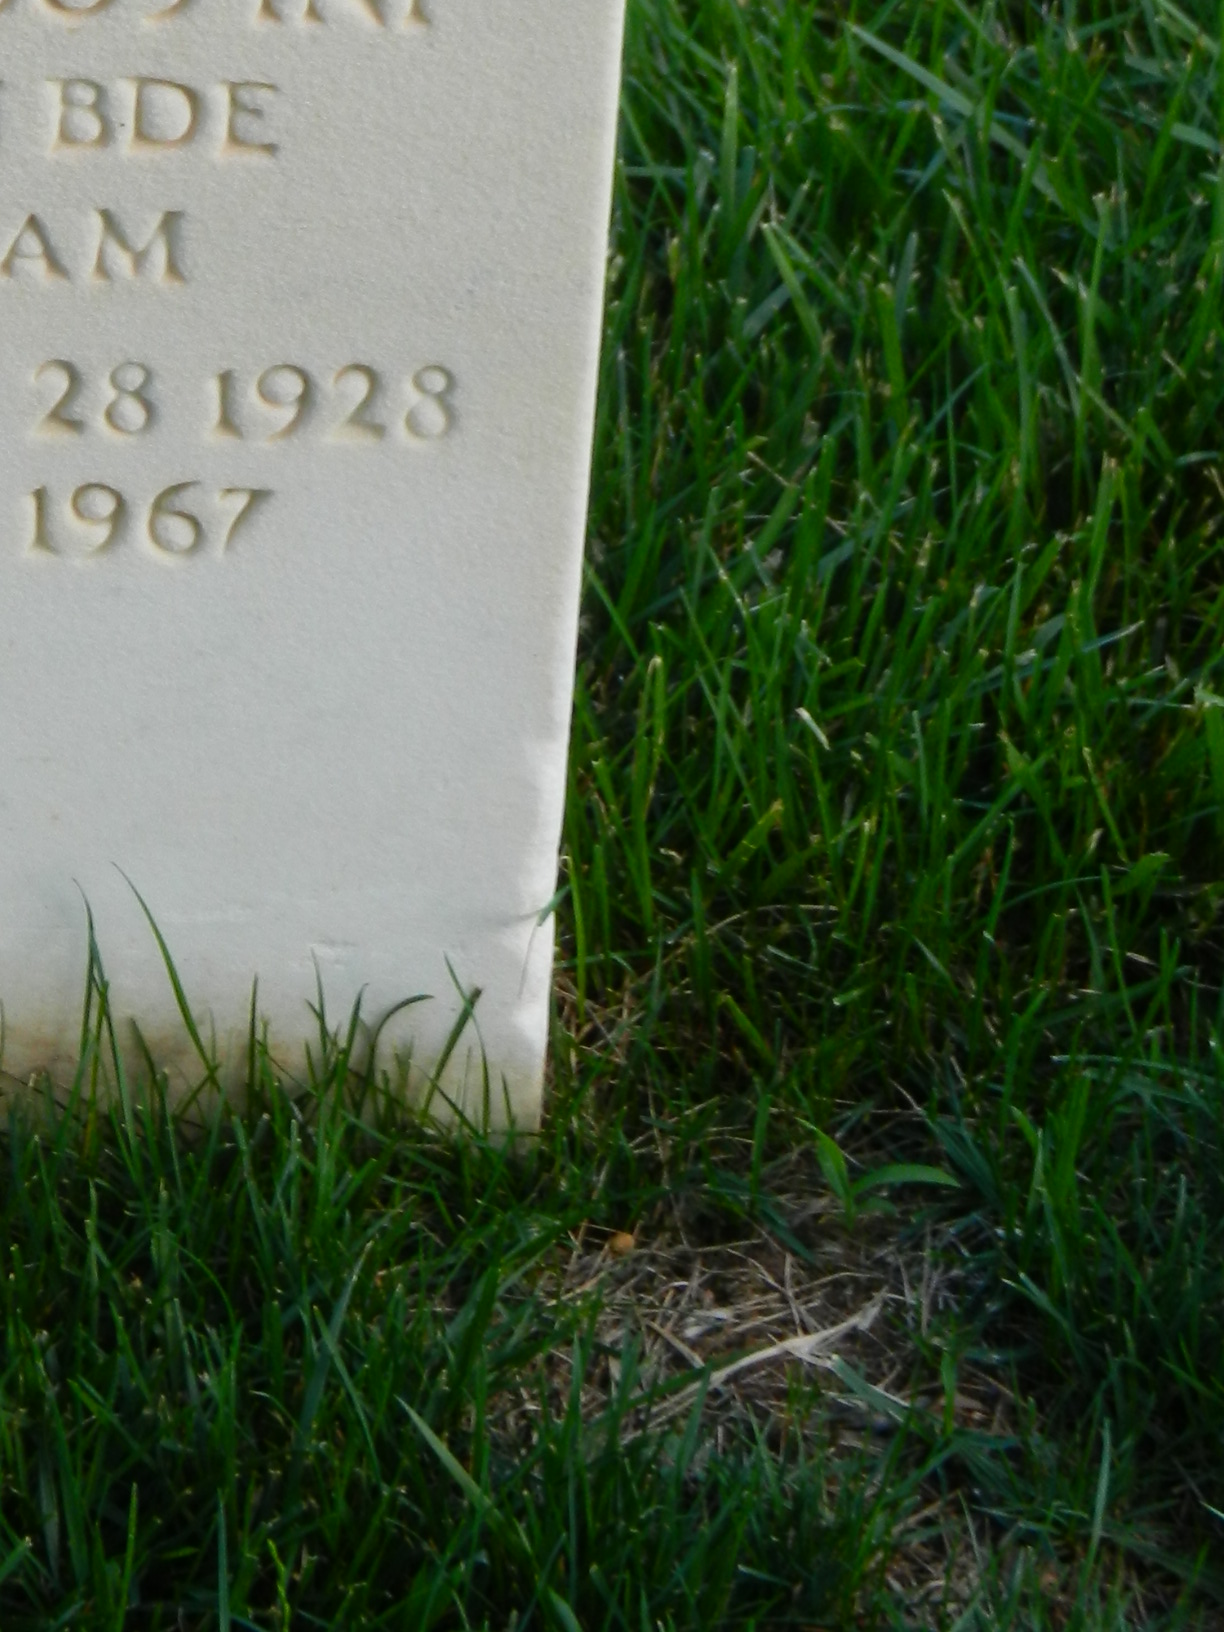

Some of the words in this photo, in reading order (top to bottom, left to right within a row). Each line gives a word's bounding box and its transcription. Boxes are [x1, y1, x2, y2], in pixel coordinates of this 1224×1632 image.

[44, 76, 281, 158] BDE
[32, 359, 160, 442] 28
[212, 363, 459, 444] 1928
[24, 480, 277, 558] 1967
